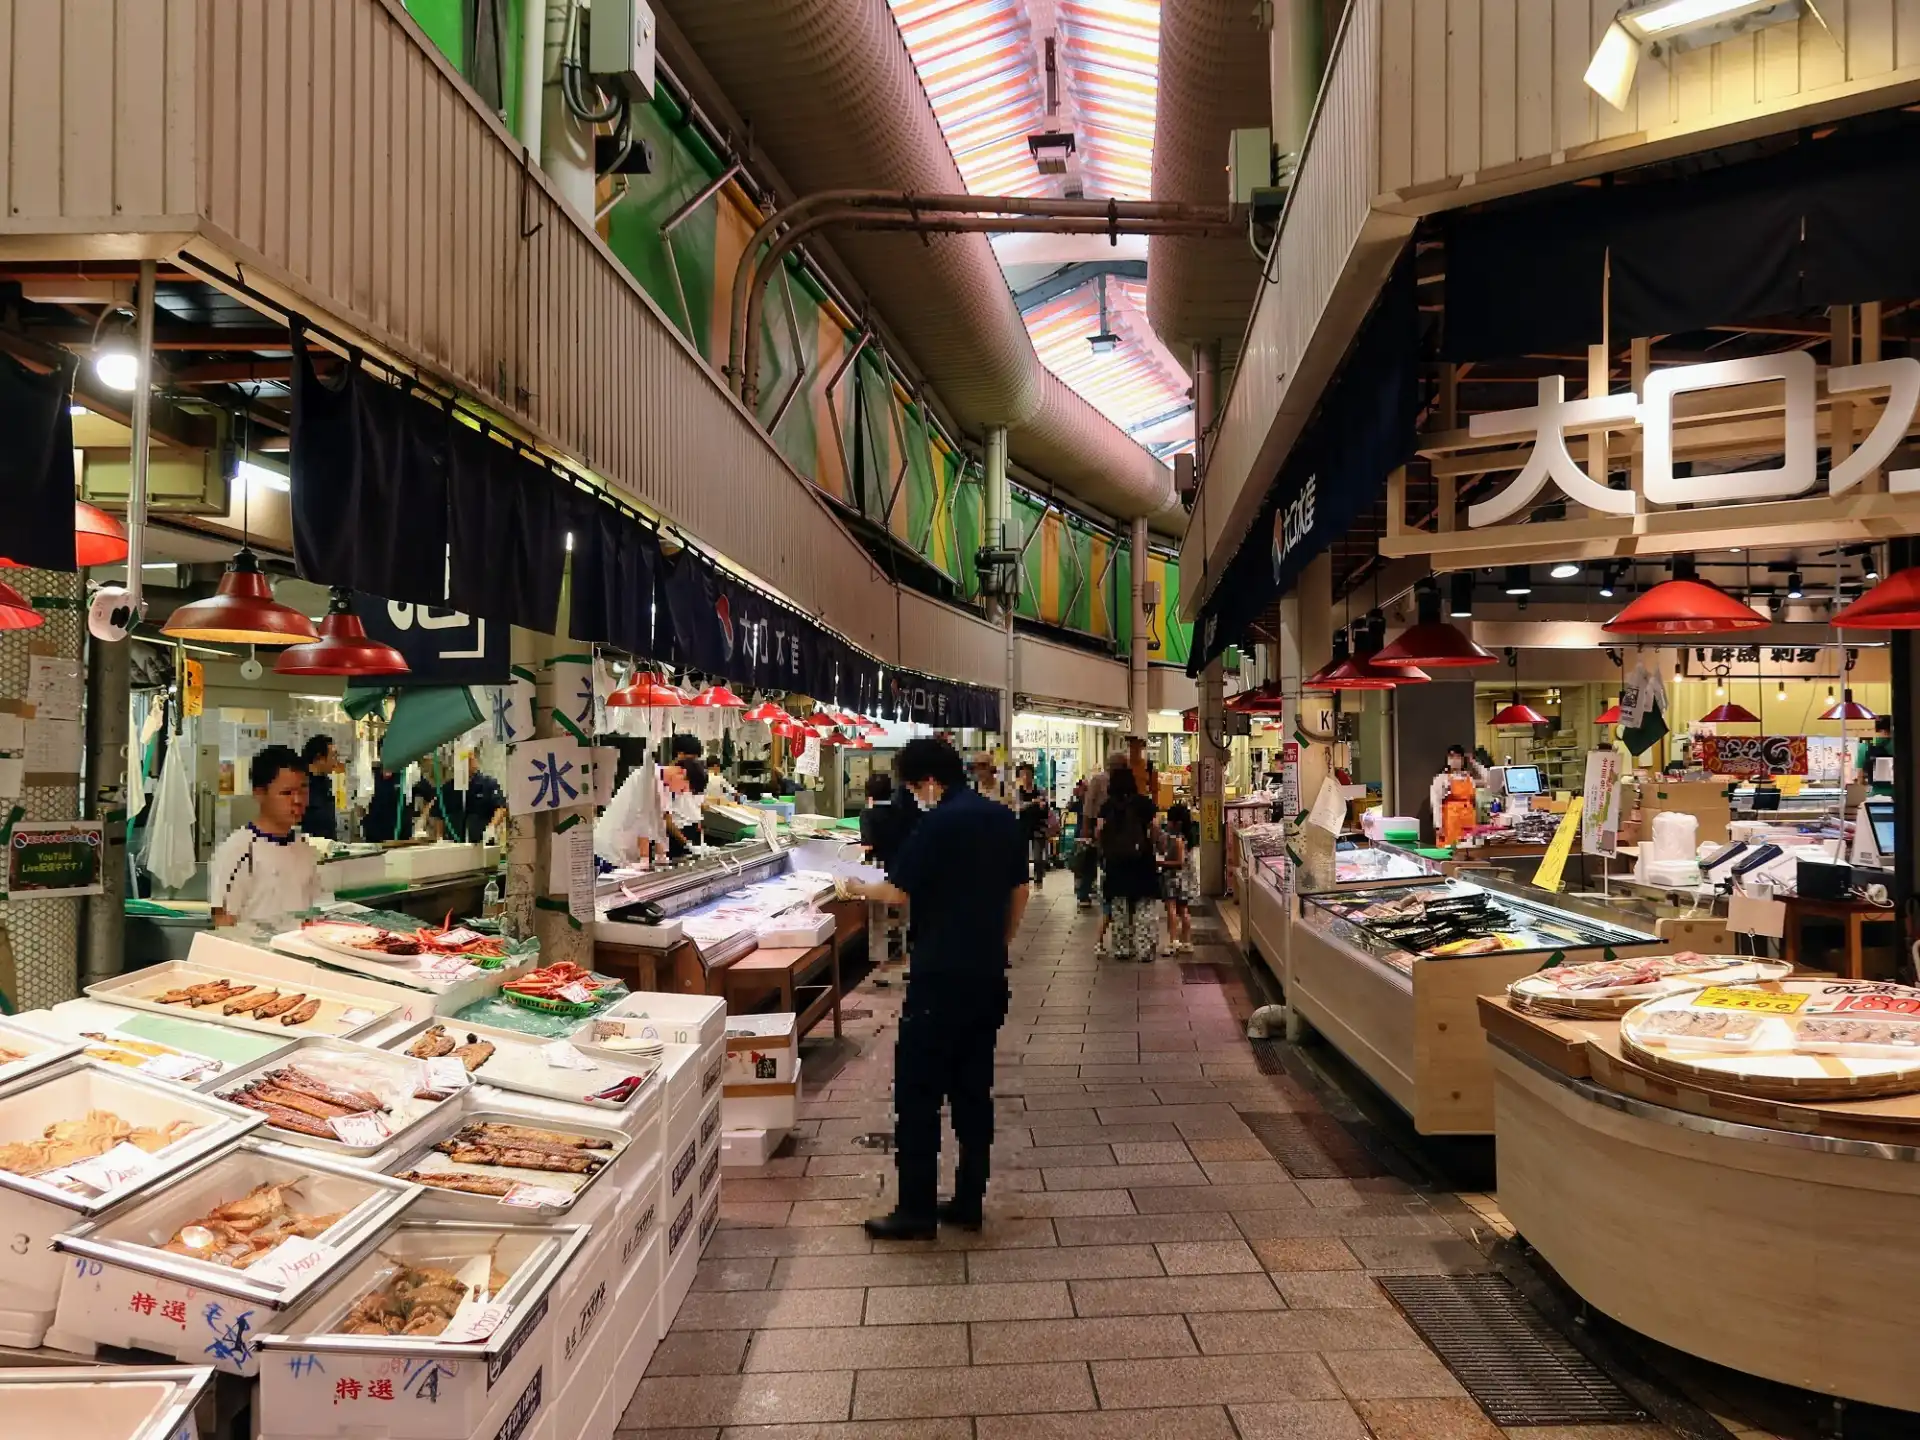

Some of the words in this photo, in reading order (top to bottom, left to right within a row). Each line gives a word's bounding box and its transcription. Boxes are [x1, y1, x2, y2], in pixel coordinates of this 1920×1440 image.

[528, 752, 579, 808] 氷
[131, 1291, 187, 1326] 特選
[335, 1377, 395, 1401] 特選
